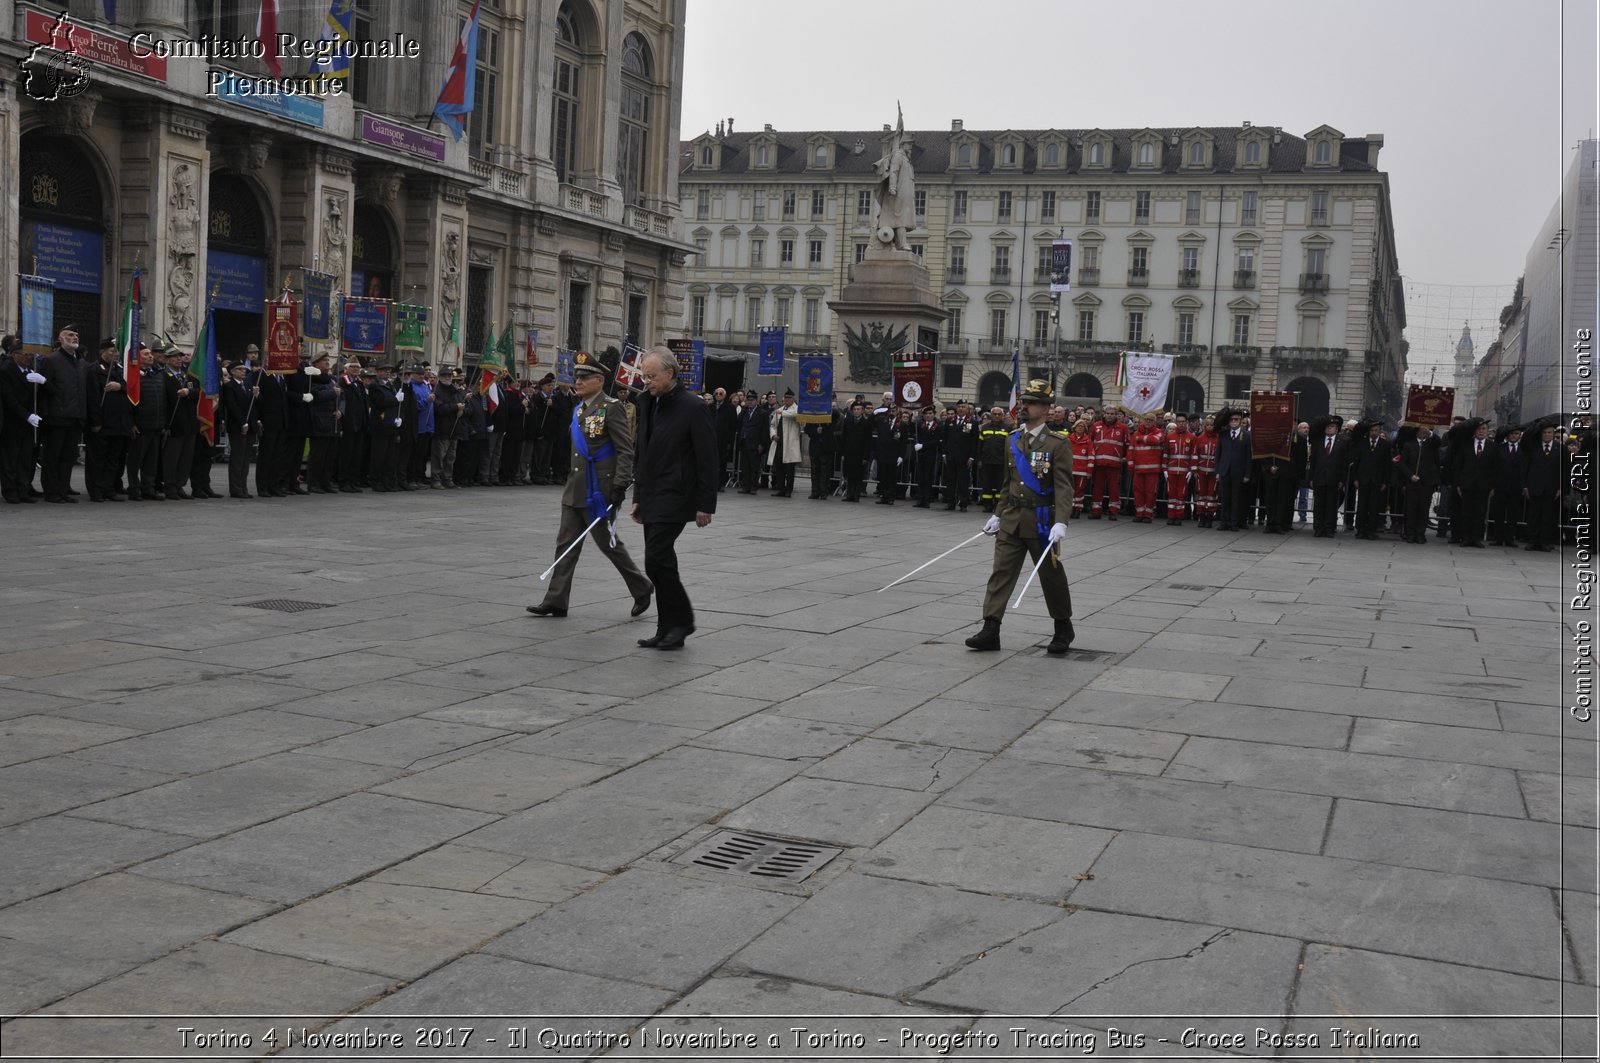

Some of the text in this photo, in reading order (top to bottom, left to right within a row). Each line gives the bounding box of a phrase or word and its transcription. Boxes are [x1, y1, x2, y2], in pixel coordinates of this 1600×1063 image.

[90, 32, 119, 54] Ferré
[79, 43, 99, 59] Sotto
[129, 58, 146, 73] luce
[371, 120, 405, 140] Giansone
[1131, 364, 1165, 374] CROCE ROSSA
